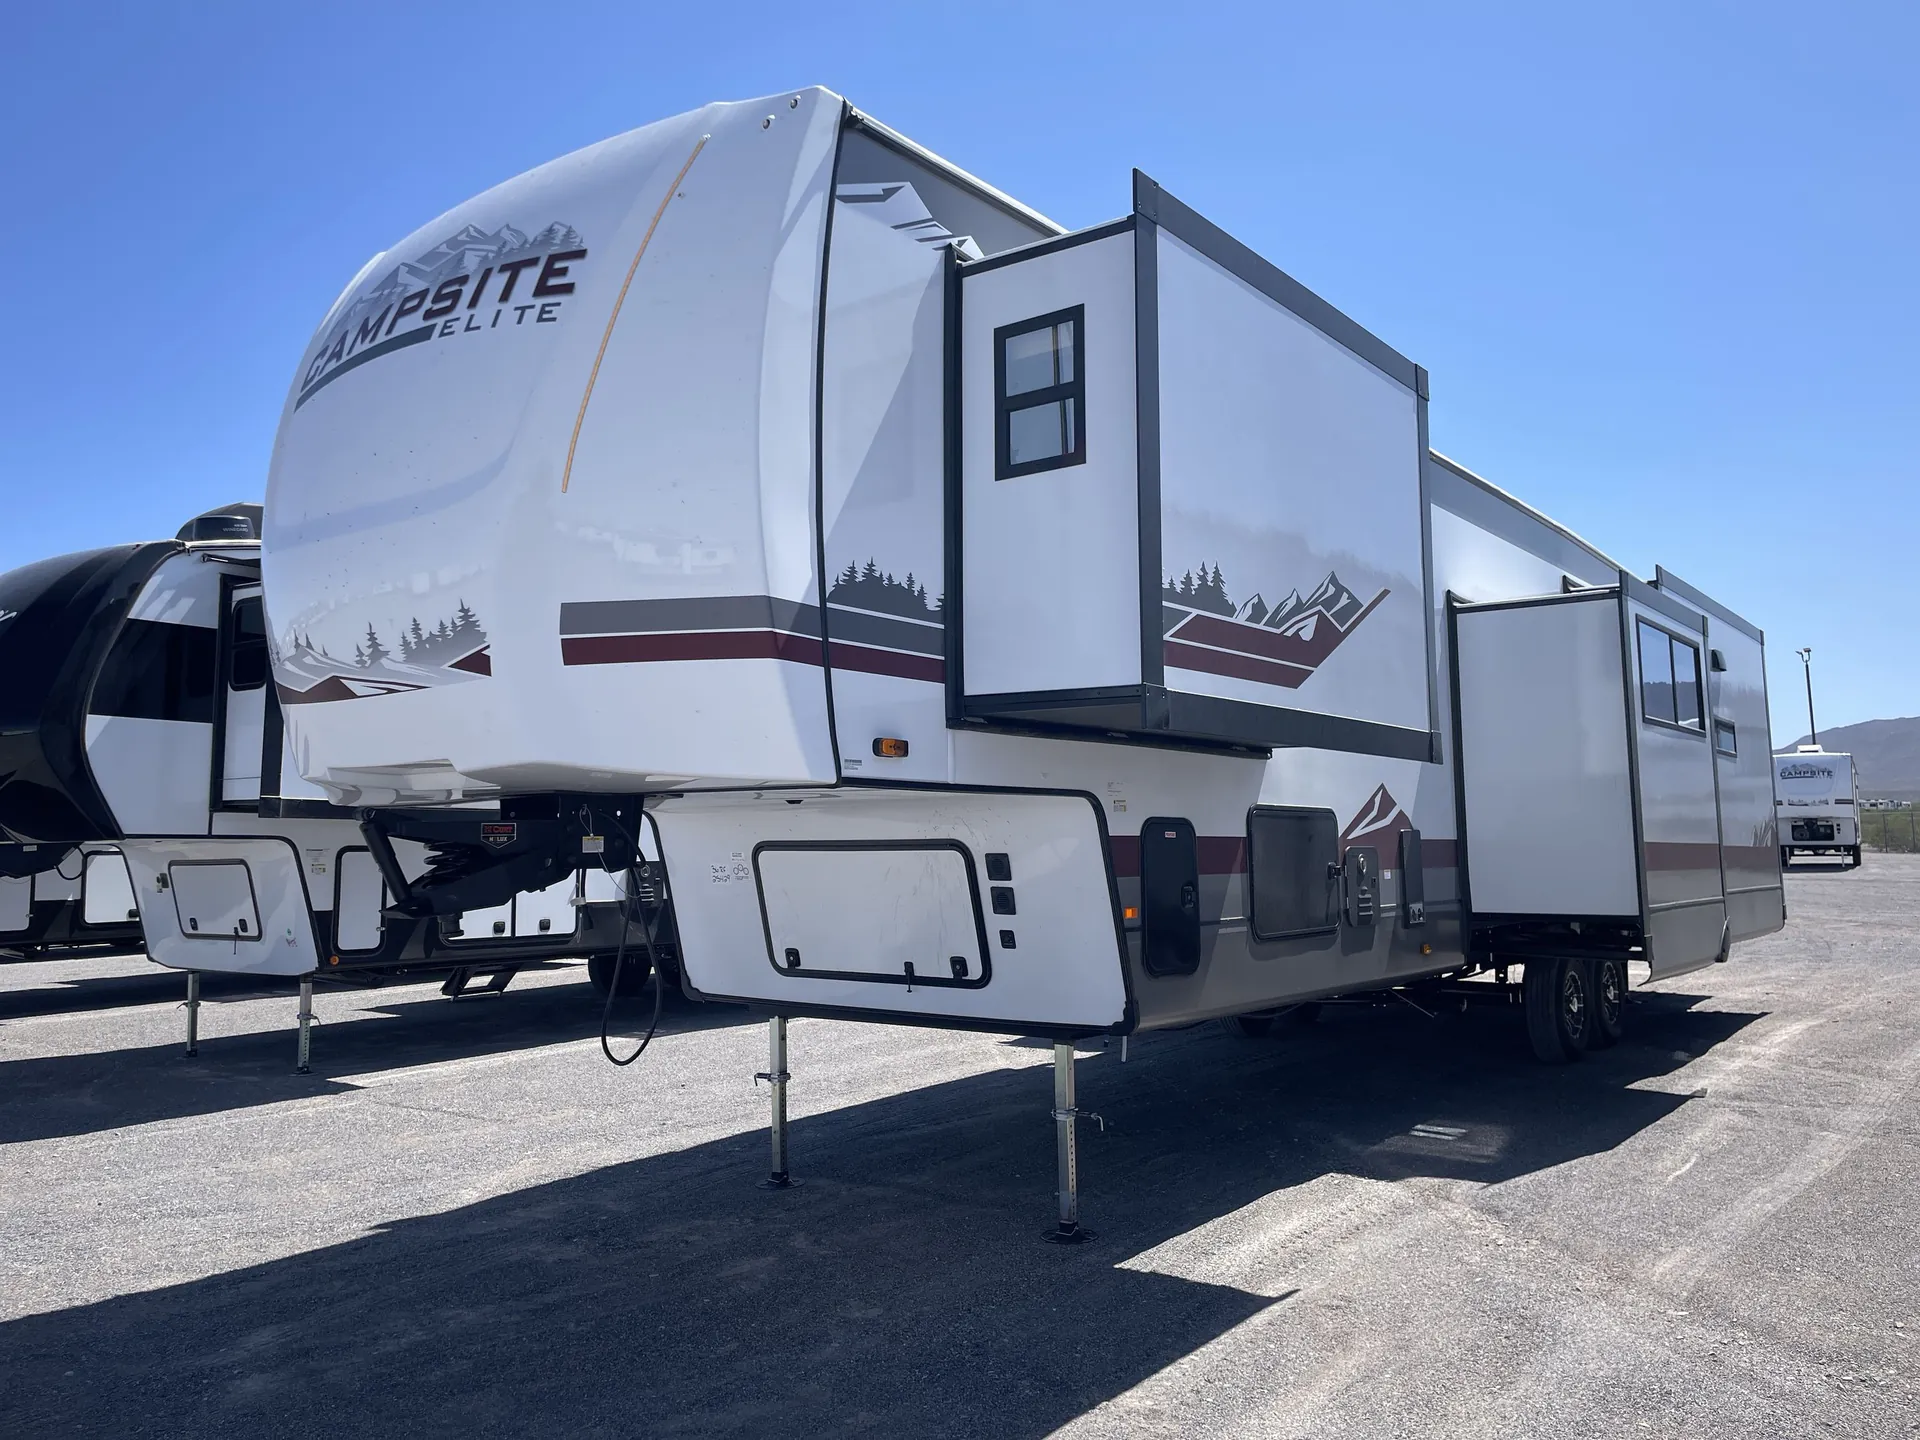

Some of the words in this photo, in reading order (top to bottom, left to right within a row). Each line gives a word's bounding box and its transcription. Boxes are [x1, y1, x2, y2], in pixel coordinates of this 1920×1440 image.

[300, 249, 588, 394] CAMPSITE
[438, 302, 562, 338] ELITE
[1780, 770, 1834, 778] CAMPSITE
